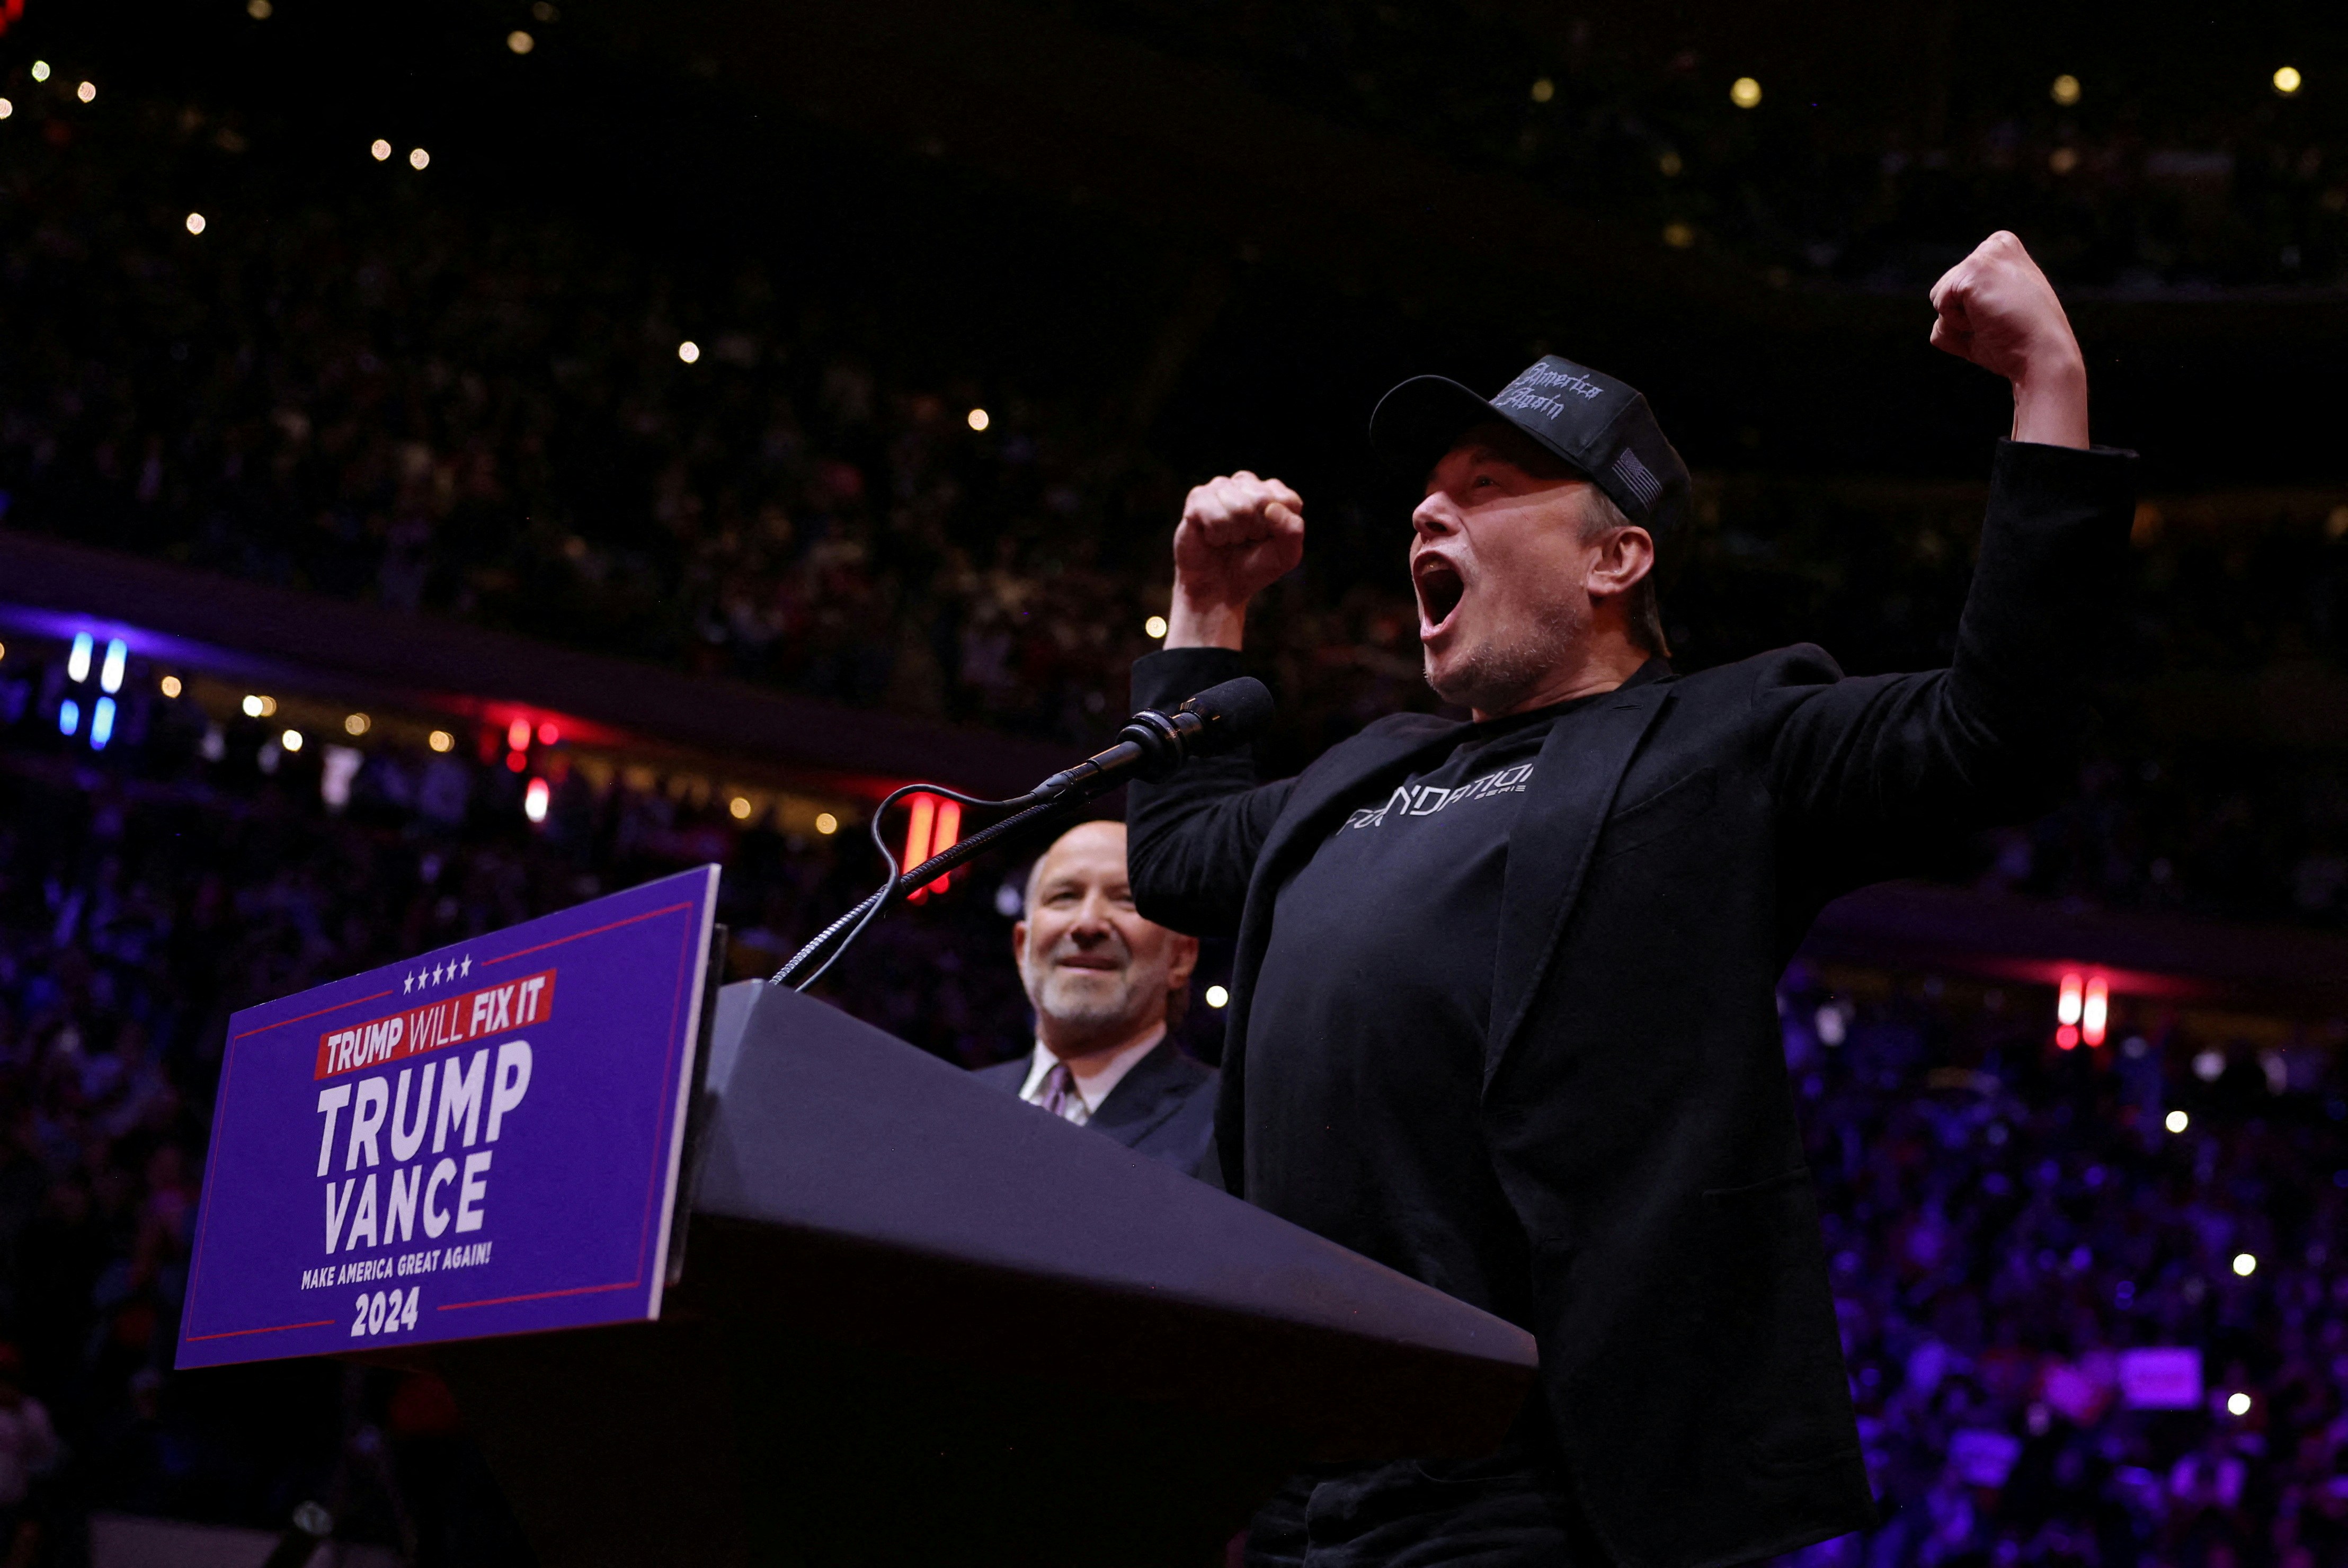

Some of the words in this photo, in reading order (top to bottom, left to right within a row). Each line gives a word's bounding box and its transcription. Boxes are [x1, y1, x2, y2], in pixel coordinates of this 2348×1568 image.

[1496, 387, 1565, 420] Again
[1515, 362, 1604, 400] America
[327, 1017, 404, 1073] TRUMP
[410, 1000, 463, 1052] WILL
[470, 984, 513, 1037] FIX
[515, 977, 546, 1024] IT
[316, 1040, 532, 1177] TRUMP
[325, 1150, 493, 1254] VANCE
[301, 1266, 335, 1290] MAKE
[337, 1257, 393, 1285] AMERICA
[398, 1249, 440, 1276] GREAT
[442, 1242, 493, 1269] AGAIN!
[351, 1286, 420, 1337] 2024
